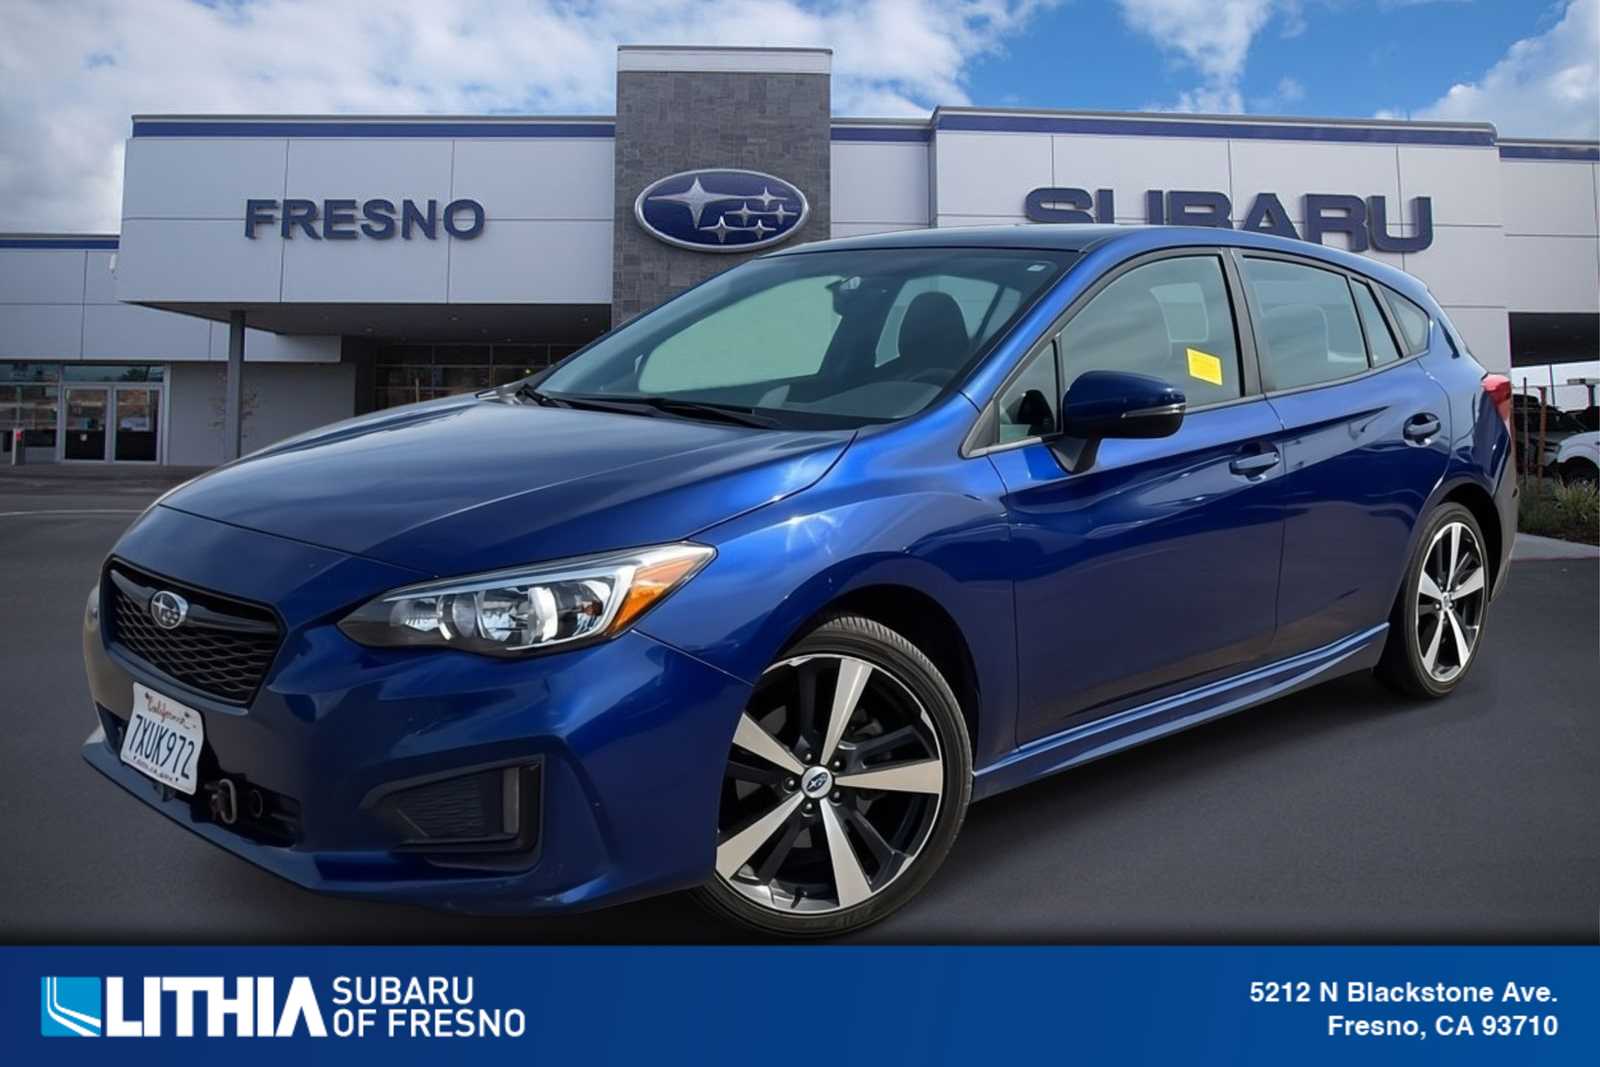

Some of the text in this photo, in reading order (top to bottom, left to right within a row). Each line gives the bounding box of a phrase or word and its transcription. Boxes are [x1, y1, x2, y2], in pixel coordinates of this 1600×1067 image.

[244, 198, 486, 240] FRESNO
[1024, 187, 1433, 253] SUBARU
[129, 714, 195, 780] 7XUK972
